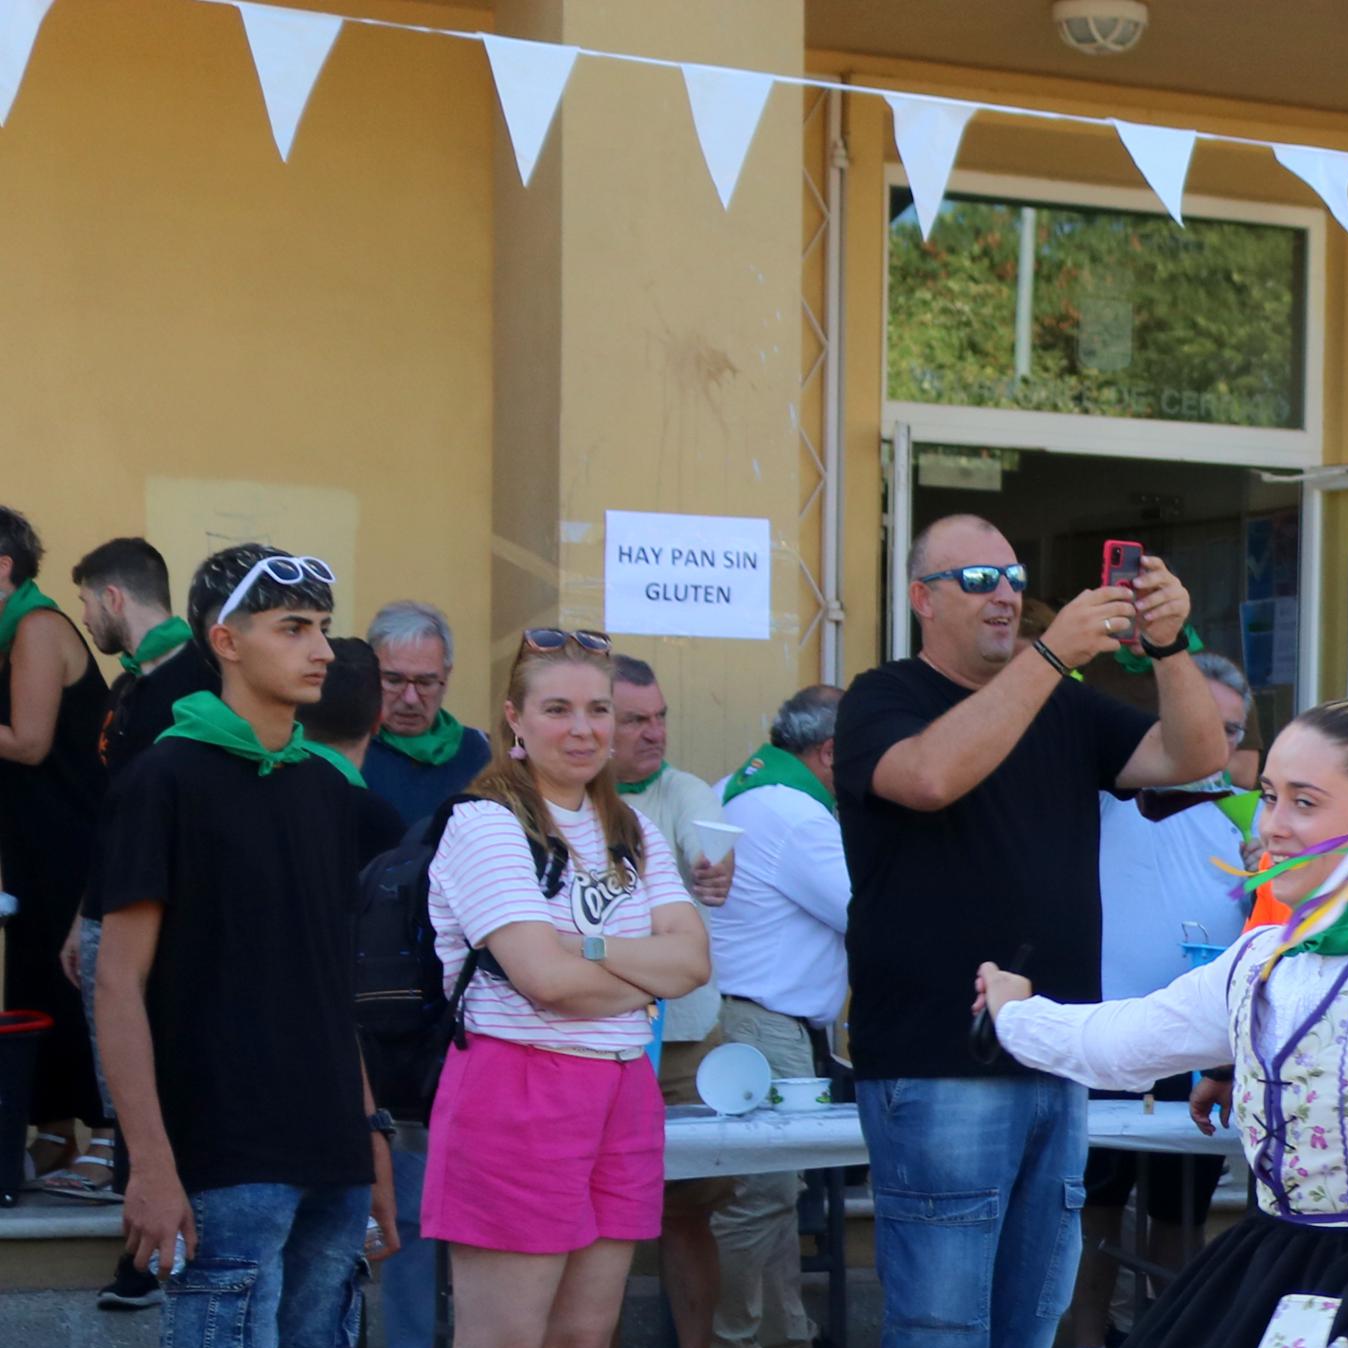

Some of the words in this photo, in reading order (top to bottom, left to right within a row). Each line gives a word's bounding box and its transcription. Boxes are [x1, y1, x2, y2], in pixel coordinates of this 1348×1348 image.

[618, 545, 663, 565] HAY
[671, 548, 716, 568] PAN
[723, 550, 758, 570] SIN
[645, 582, 732, 604] GLUTEN
